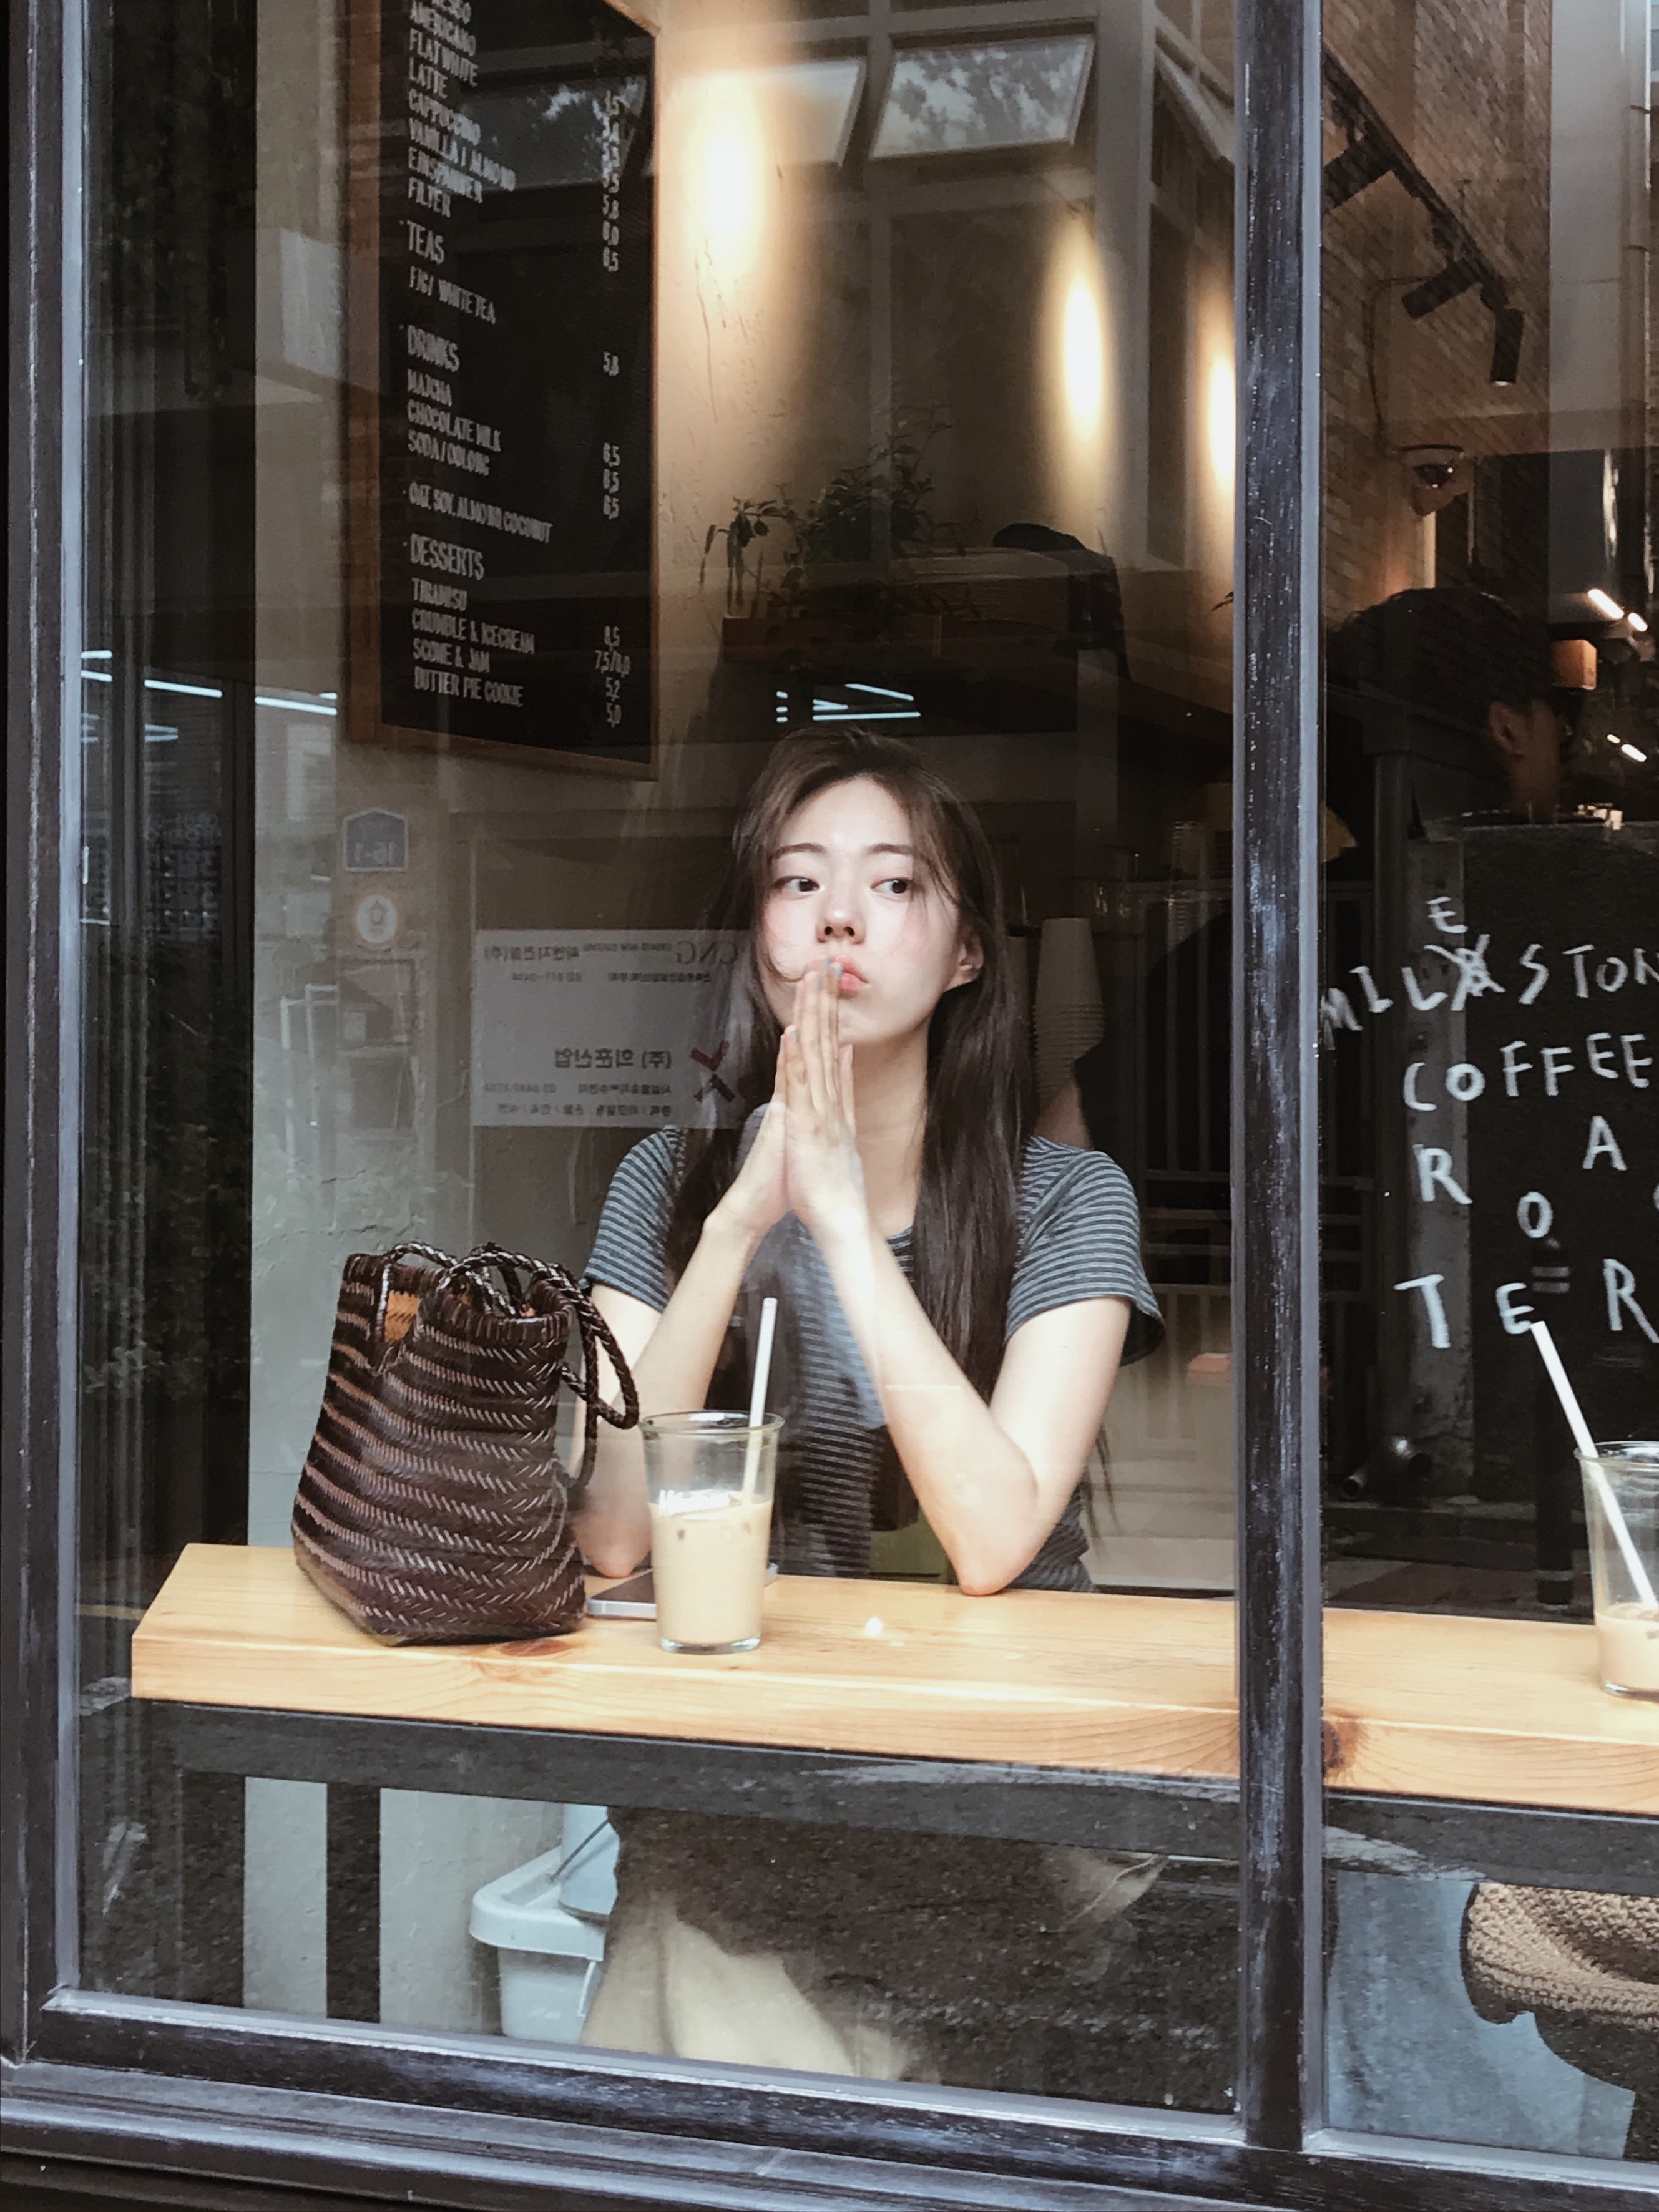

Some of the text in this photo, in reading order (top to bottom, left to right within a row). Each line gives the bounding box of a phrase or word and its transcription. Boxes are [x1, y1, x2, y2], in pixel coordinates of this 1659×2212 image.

[409, 28, 441, 64] FLAT
[409, 57, 448, 99] LATTE
[408, 177, 451, 218] FILTER
[407, 220, 444, 264] TEAS
[438, 280, 473, 313] WHITE
[474, 292, 496, 324] TEA
[408, 325, 460, 372] DRINKS
[408, 399, 501, 452] CHOCOLATE MILK
[504, 510, 553, 544] COCONUT
[411, 532, 484, 580] DESSERTS
[412, 577, 467, 611] TIRAMISU
[412, 607, 466, 641] CRUMBLE
[413, 638, 453, 666] SCONE
[469, 648, 490, 673] JAM
[414, 666, 524, 708] BUTTER PIE COOKIE
[1402, 1031, 1653, 1112] COFFEE
